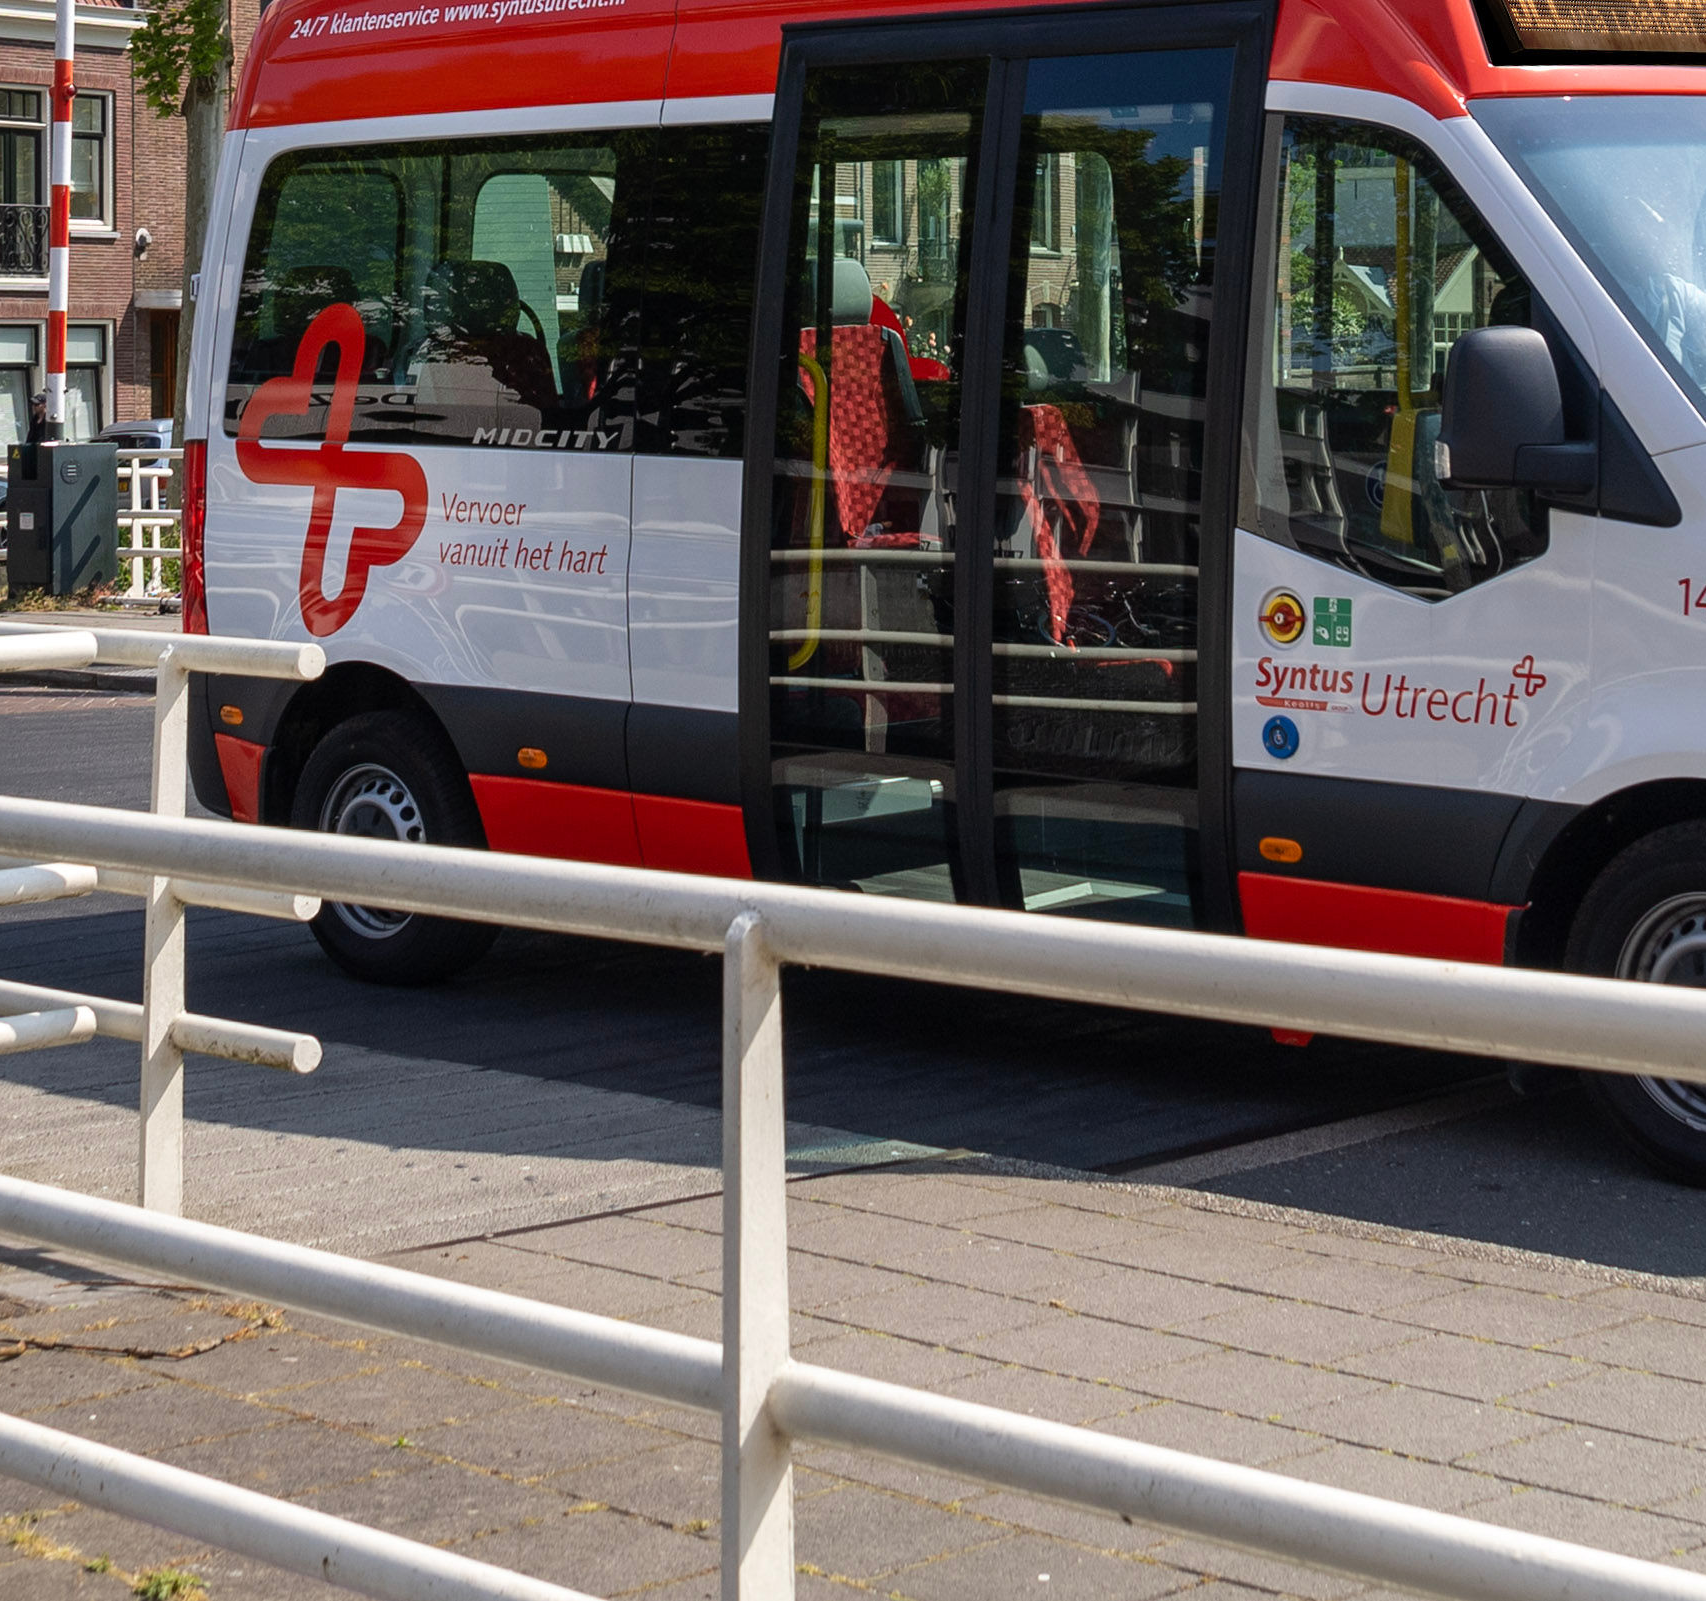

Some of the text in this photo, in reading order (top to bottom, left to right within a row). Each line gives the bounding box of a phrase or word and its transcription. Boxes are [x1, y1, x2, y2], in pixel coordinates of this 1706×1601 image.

[290, 15, 327, 40] 24/7
[329, 5, 441, 35] klantenservice
[472, 427, 619, 449] MIDCITY
[441, 492, 527, 526] Vervoer
[439, 537, 608, 575] vanuit het hart
[1255, 656, 1520, 728] Syntus Utrecht
